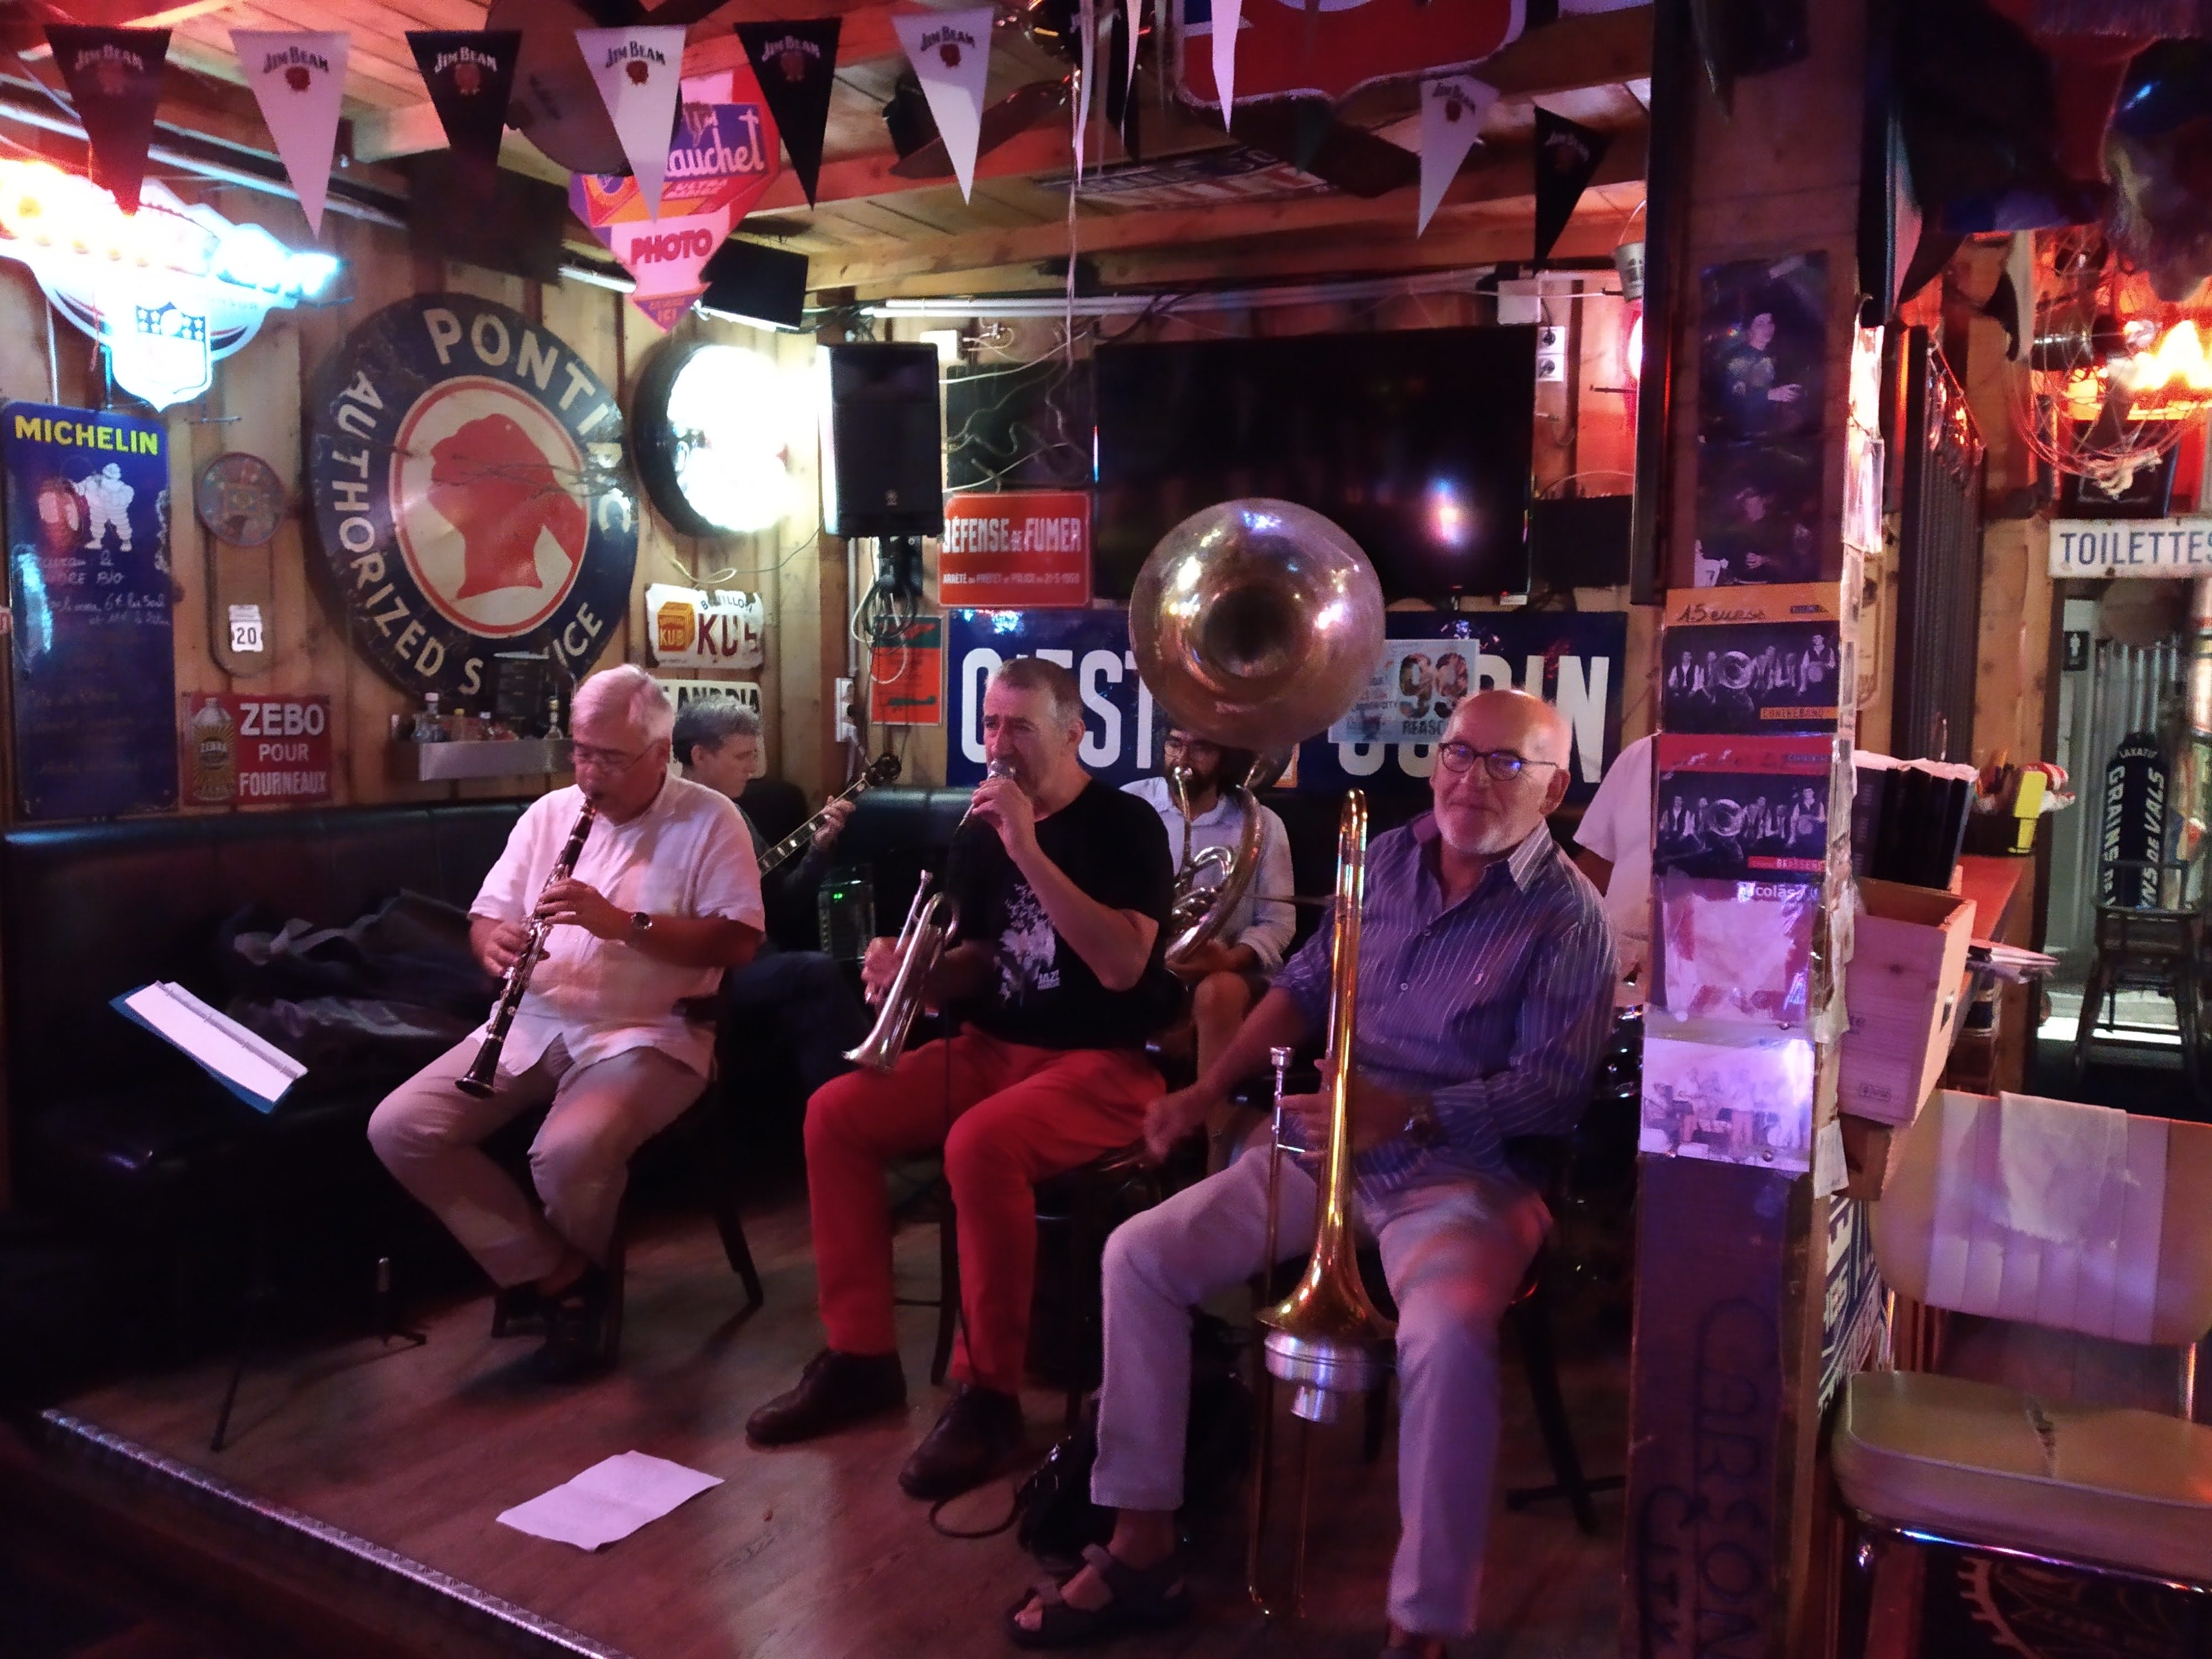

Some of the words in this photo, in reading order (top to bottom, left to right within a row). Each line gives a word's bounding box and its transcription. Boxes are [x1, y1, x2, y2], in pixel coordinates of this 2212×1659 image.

[434, 53, 458, 74] JIM
[460, 46, 498, 72] BEAM
[605, 45, 628, 69] JIM
[629, 40, 665, 66] BEAM
[761, 41, 784, 62] JIM
[785, 35, 821, 58] BEAM
[666, 108, 765, 178] auchet
[630, 228, 713, 265] PHOTO
[14, 415, 159, 456] MICHELIN
[331, 370, 446, 677] AUTHORIZED
[1024, 517, 1082, 552] FUMER
[236, 627, 257, 645] 20
[458, 602, 604, 696] SICE
[1399, 653, 1469, 719] 99
[239, 702, 325, 736] ZEBO
[1402, 720, 1447, 735] REASO
[259, 743, 310, 762] POUR
[239, 771, 328, 796] FOURNEAUX
